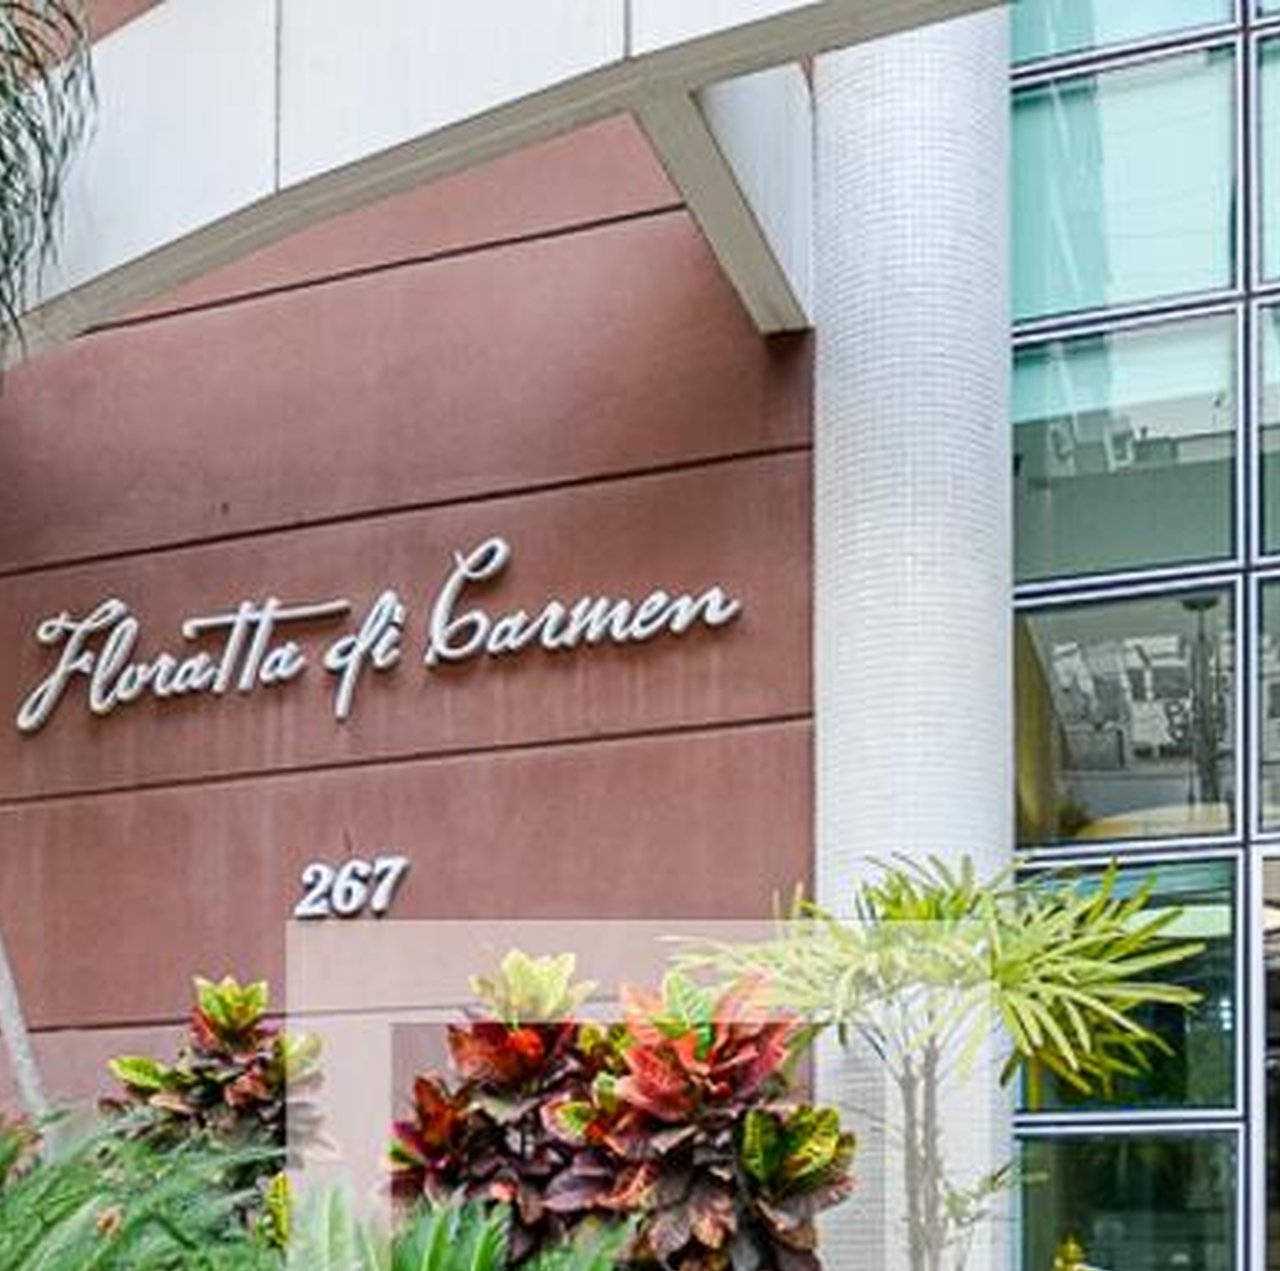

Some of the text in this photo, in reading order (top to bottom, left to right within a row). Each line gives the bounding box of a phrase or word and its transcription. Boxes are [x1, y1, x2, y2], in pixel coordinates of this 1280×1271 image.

[17, 536, 741, 731] Floratta di Carmen
[294, 856, 408, 918] 267
